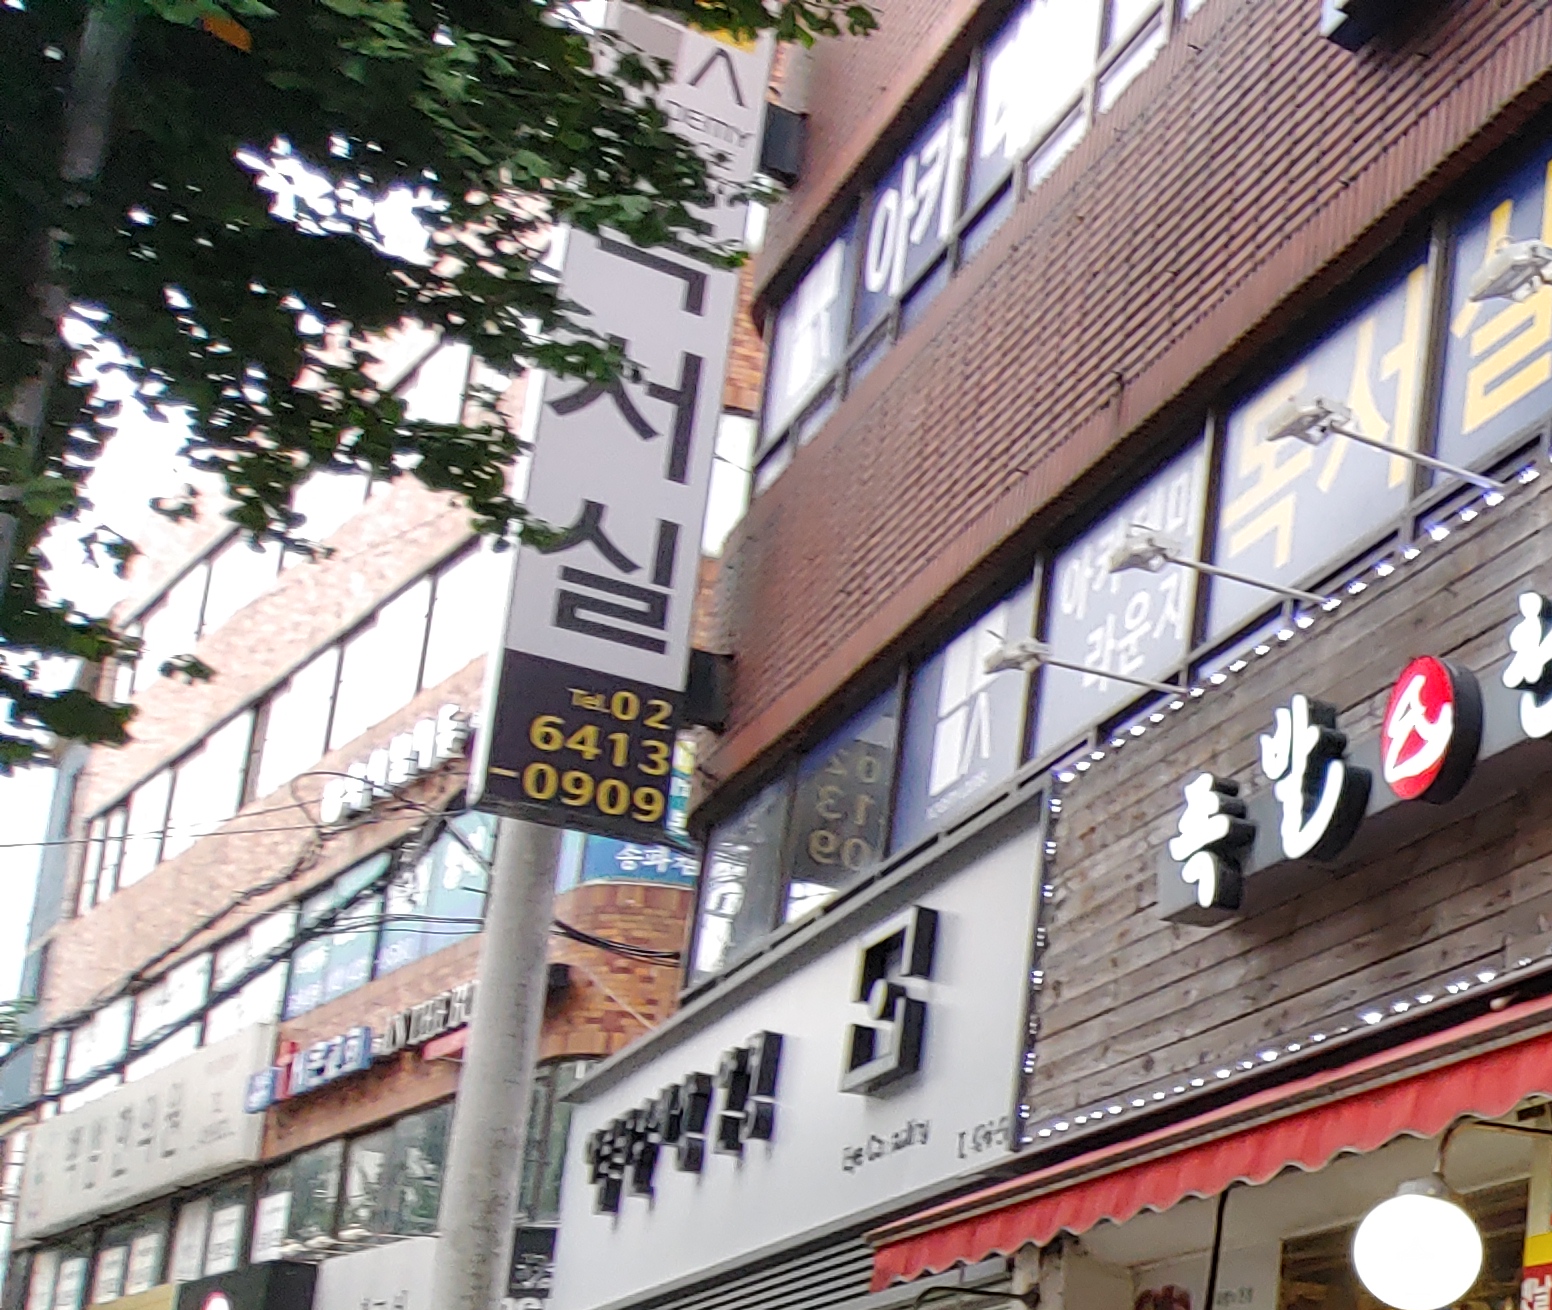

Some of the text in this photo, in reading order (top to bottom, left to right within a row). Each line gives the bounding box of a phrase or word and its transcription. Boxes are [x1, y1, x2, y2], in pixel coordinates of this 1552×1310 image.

[546, 235, 708, 656] 서실
[528, 714, 671, 777] 6413
[610, 690, 674, 730] 02
[1167, 691, 1346, 909] 족발
